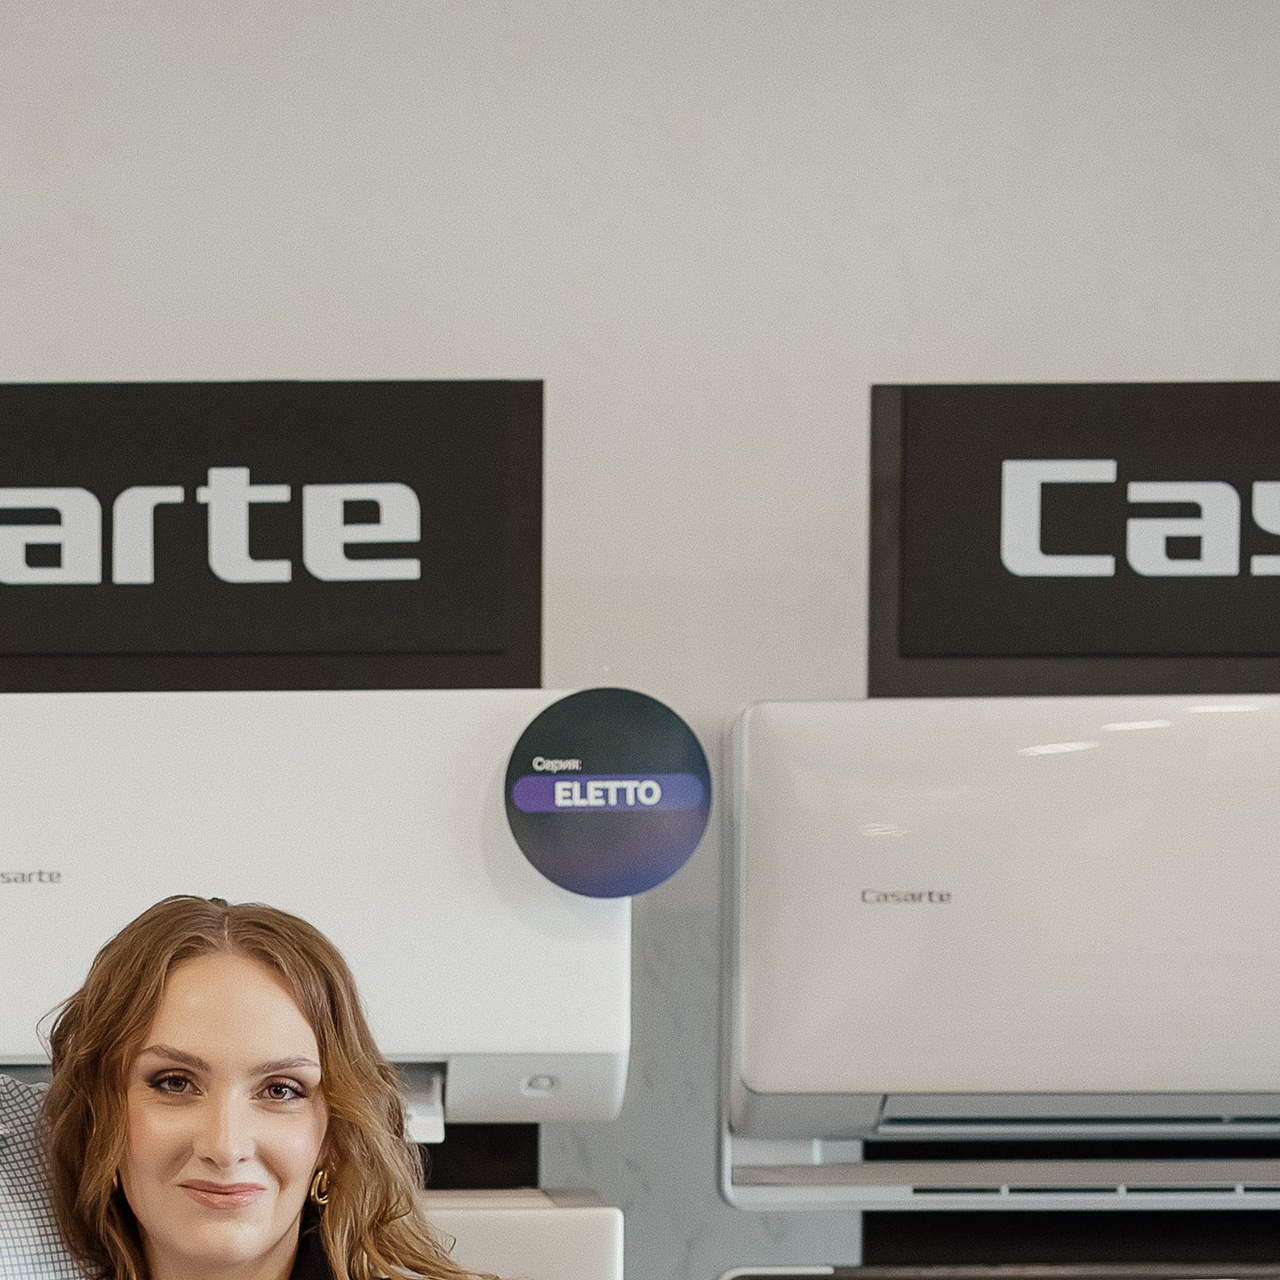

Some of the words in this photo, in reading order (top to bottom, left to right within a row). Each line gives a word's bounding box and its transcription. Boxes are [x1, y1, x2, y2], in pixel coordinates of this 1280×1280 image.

[1000, 459, 1280, 577] Ca
[554, 780, 662, 807] ELETTO
[861, 889, 951, 904] Casarte
